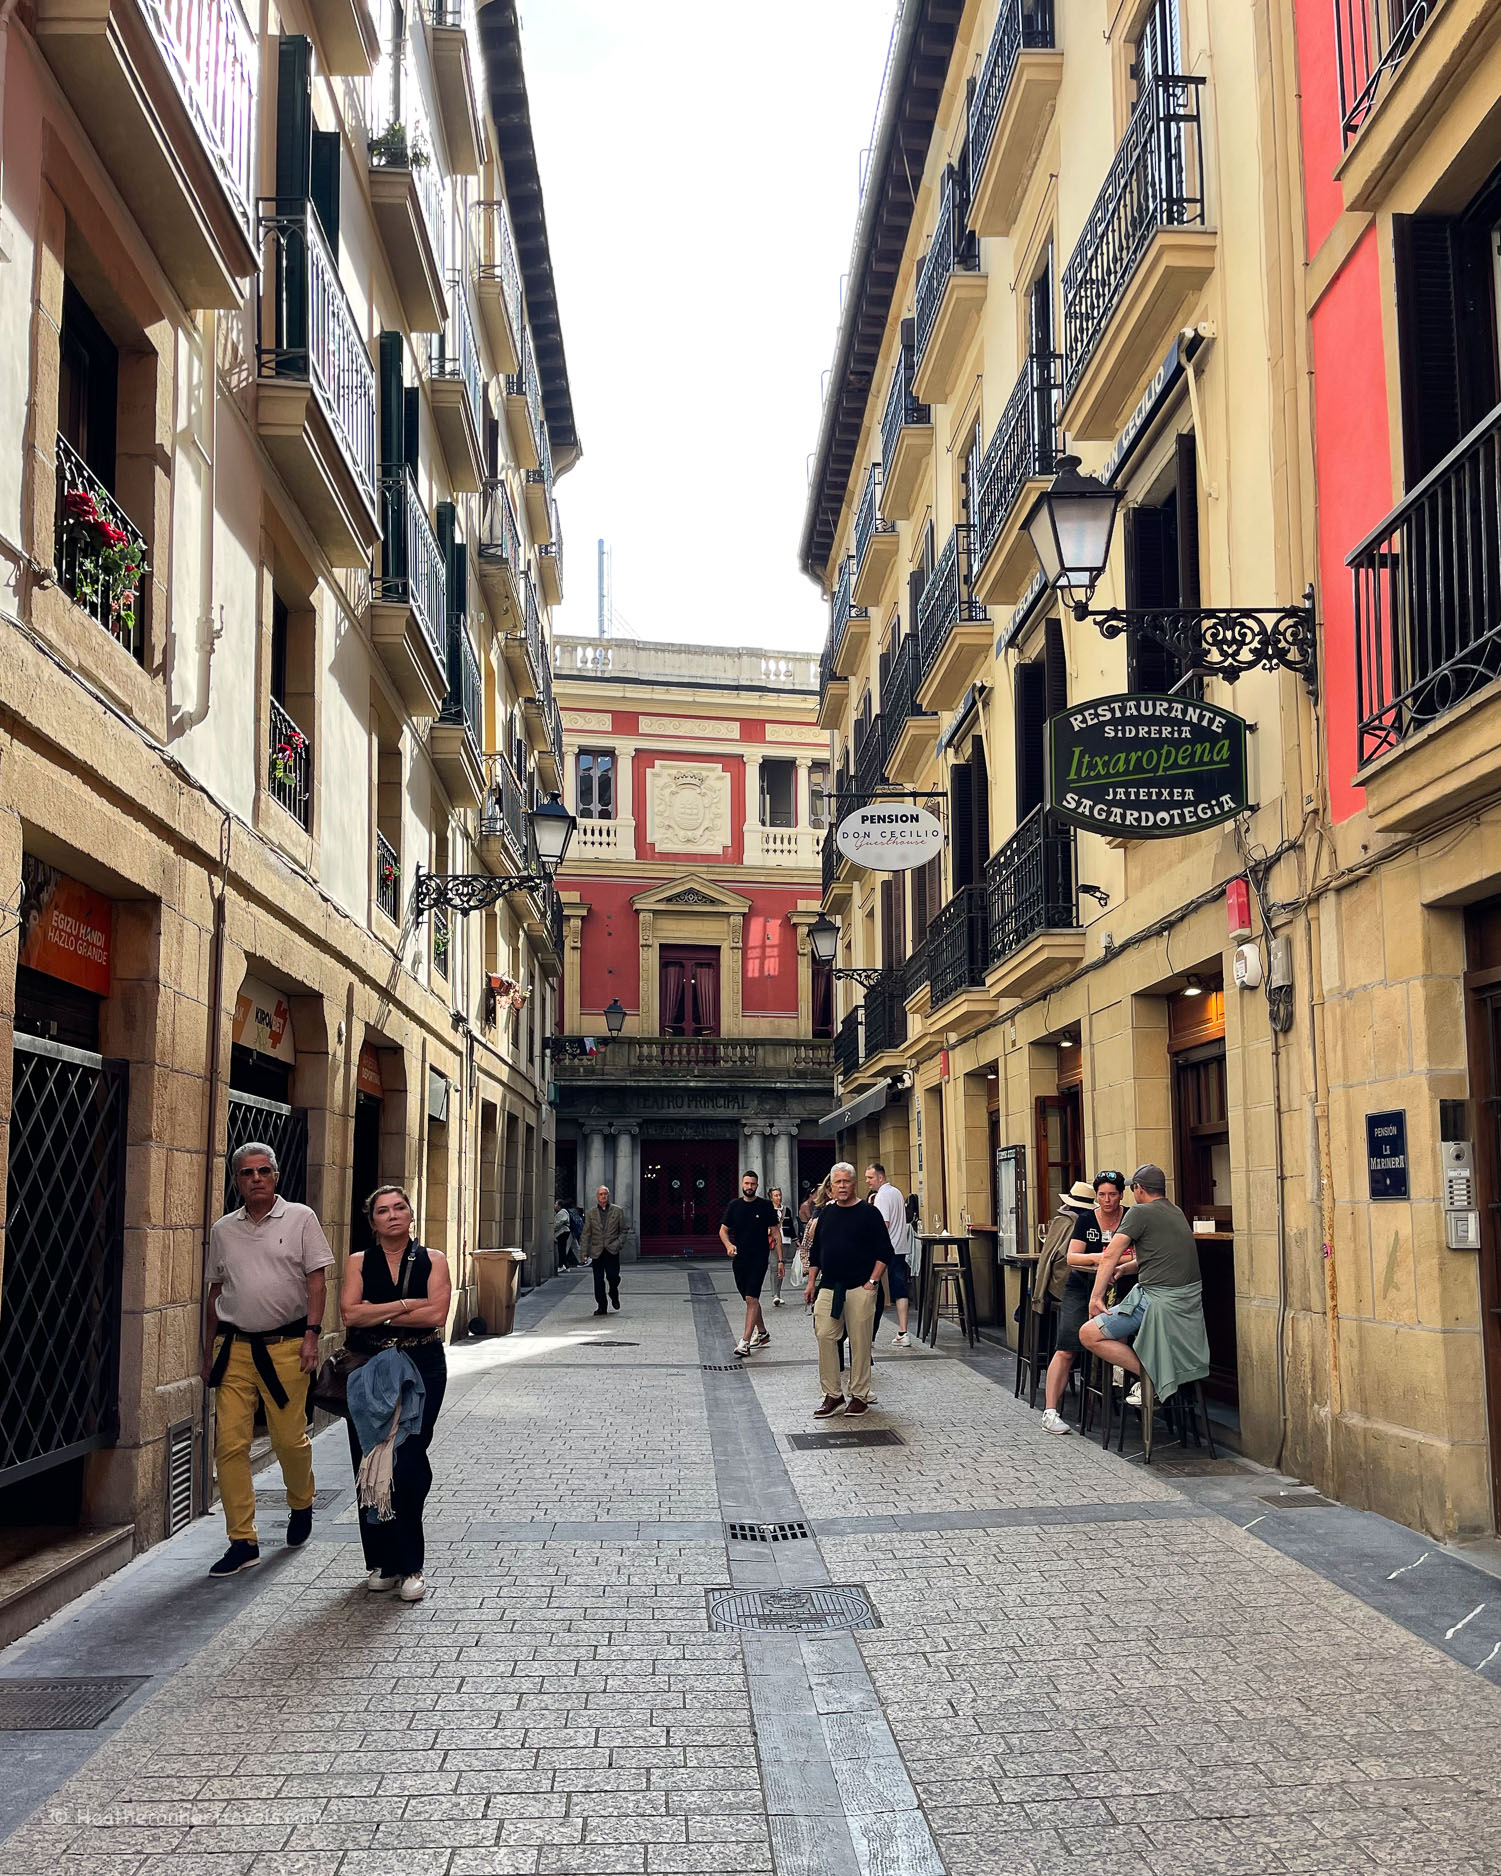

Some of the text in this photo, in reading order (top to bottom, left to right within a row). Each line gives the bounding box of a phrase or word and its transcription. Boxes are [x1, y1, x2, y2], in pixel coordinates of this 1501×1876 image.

[1122, 366, 1165, 448] CECILIO
[1069, 700, 1227, 733] RESTAURANTE
[1066, 739, 1230, 779] Itxaropena
[1105, 788, 1195, 800] JATETXEA
[861, 814, 919, 824] PENSION
[842, 830, 939, 839] DON CECILIO
[855, 835, 927, 850] Guesthouse
[52, 910, 105, 948] EGIZU HANDI
[48, 926, 108, 965] HAZLO GRANDE
[688, 1093, 749, 1109] PRINCIPAL
[1374, 1124, 1397, 1137] PENSIÓN
